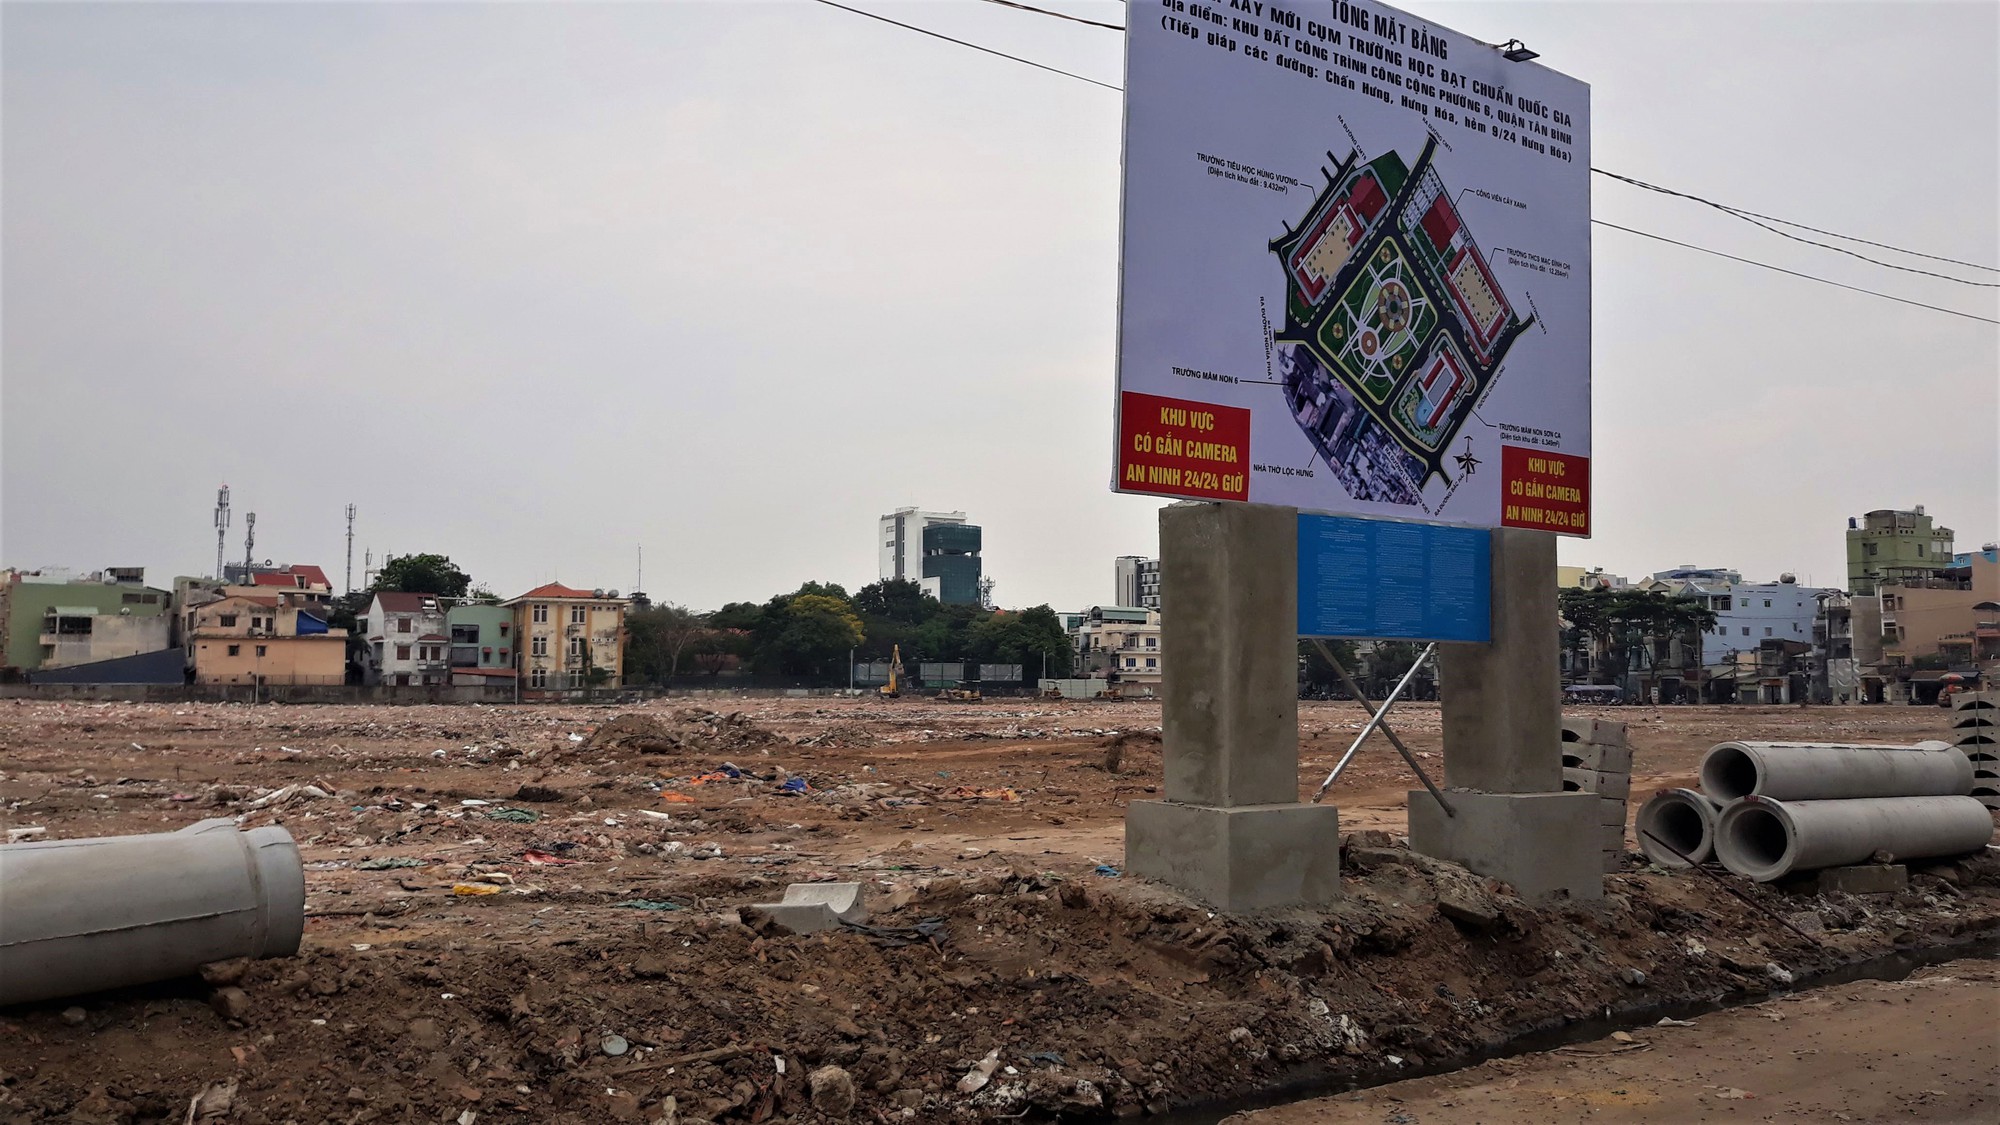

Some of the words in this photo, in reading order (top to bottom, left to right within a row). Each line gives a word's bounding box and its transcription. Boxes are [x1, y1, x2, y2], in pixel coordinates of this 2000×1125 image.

[1374, 14, 1406, 45] MẶT
[1411, 25, 1447, 60] BẰNG
[1190, 4, 1227, 27] điểm:
[1232, 17, 1259, 37] KHU
[1264, 28, 1290, 48] ĐẤT
[1295, 39, 1328, 61] CÔNG
[1333, 52, 1367, 74] TRÌNH
[1371, 65, 1402, 87] CÔNG
[1405, 77, 1436, 98] CỘNG
[1439, 89, 1480, 113] PHƯỜNG
[1484, 105, 1494, 119] 6,
[1498, 110, 1525, 129] QUẬN
[1528, 120, 1548, 137] TÂN
[1551, 128, 1572, 145] BÌNH
[1270, 7, 1301, 31] MỚI
[1308, 21, 1341, 46] CỤM
[1348, 35, 1402, 67] TRƯỜNG
[1408, 57, 1434, 78] HỌC
[1441, 69, 1466, 88] ĐẠT
[1473, 80, 1513, 106] CHUẨN
[1518, 96, 1548, 119] QUỐC
[1553, 110, 1571, 127] GIA
[1161, 15, 1199, 39] (Tiếp
[1207, 32, 1236, 52] giáp
[1244, 45, 1268, 61] các
[1276, 54, 1318, 78] đường:
[1325, 70, 1355, 90] Chấn
[1362, 82, 1394, 105] Hưng,
[1401, 95, 1428, 115] Hưng
[1435, 106, 1458, 125] Hóa,
[1492, 126, 1517, 143] 9/24
[1522, 136, 1545, 154] Hưng
[1550, 145, 1572, 163] Hóa)
[1197, 152, 1226, 167] TRƯỜNG
[1241, 165, 1256, 175] HỌC
[1275, 174, 1299, 186] VƯƠNG
[1236, 174, 1249, 184] khu
[1171, 366, 1201, 379] TRƯỜNG
[1218, 374, 1233, 384] NON
[1234, 376, 1239, 385] 6
[1160, 406, 1187, 428] KHU
[1190, 410, 1215, 433] VỰC
[1134, 431, 1152, 454] CÓ
[1155, 431, 1183, 457] GẮN
[1186, 440, 1238, 463] CAMERA
[1126, 463, 1146, 483] AN
[1149, 466, 1181, 487] NINH
[1184, 470, 1219, 491] 24/24
[1222, 471, 1244, 493] GIỜ
[1253, 462, 1267, 473] NHÀ
[1267, 465, 1281, 475] THỜ
[1295, 469, 1314, 478] HƯNG
[1528, 457, 1546, 474] KHU
[1548, 460, 1565, 479] VỰC
[1510, 478, 1523, 496] CÓ
[1525, 477, 1544, 498] GẮN
[1546, 484, 1581, 503] CAMERA
[1506, 505, 1519, 520] AN
[1521, 506, 1543, 523] NINH
[1545, 509, 1569, 526] 24/24
[1570, 510, 1586, 528] GIỜ
